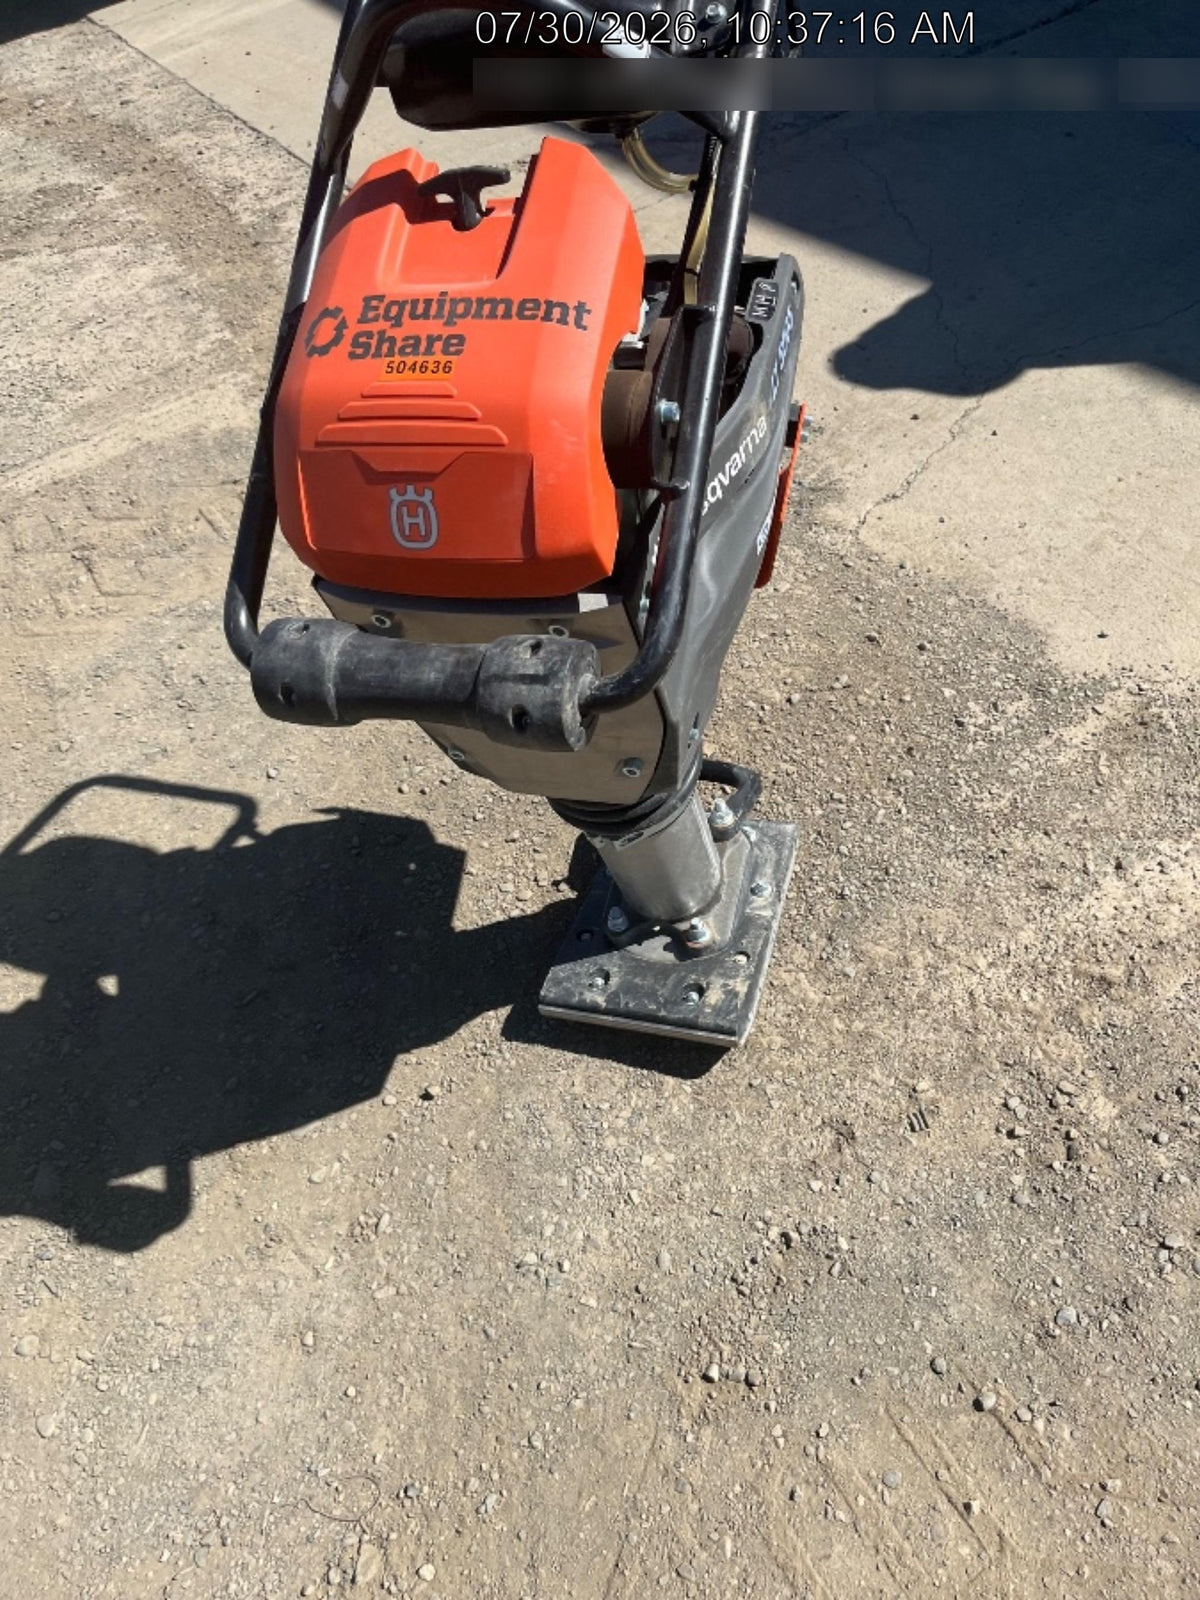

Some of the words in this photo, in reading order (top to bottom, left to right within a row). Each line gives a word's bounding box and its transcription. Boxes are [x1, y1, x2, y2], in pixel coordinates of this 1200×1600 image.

[357, 291, 592, 331] Equipment
[348, 330, 466, 360] Share
[384, 360, 453, 374] 504636
[701, 415, 767, 516] qvarna
